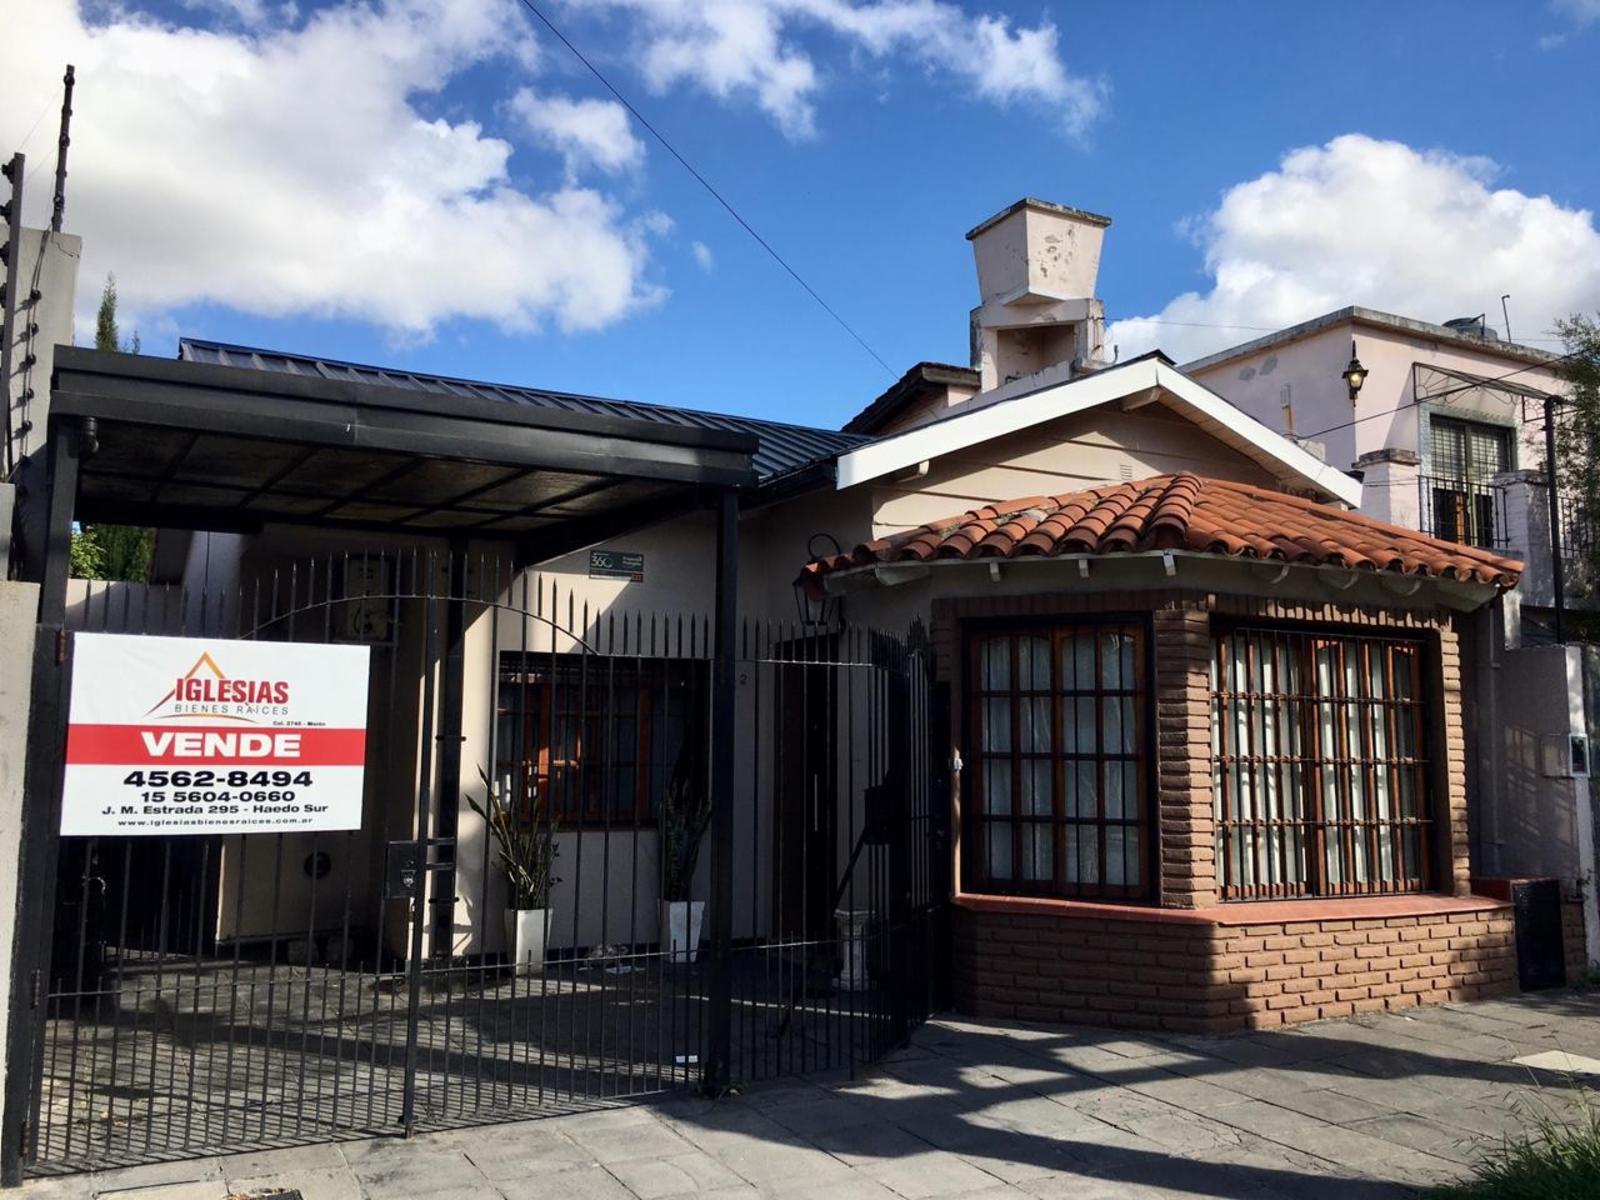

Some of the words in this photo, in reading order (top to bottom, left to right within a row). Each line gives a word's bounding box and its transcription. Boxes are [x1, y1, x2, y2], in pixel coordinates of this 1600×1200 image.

[176, 678, 289, 704] IGLESIAS
[174, 704, 229, 714] BIENES
[141, 731, 302, 758] VENDE
[123, 770, 314, 788] 4562-8494
[141, 791, 165, 802] 15
[172, 791, 296, 803] 5604-0660
[102, 806, 115, 816] J.
[120, 806, 139, 815] M.
[143, 805, 204, 815] Estrada
[208, 804, 239, 814] 295
[253, 803, 300, 814] Haedo
[304, 803, 329, 813] Sur
[118, 817, 314, 828] www.iglesiasbienesraices.com.ar
